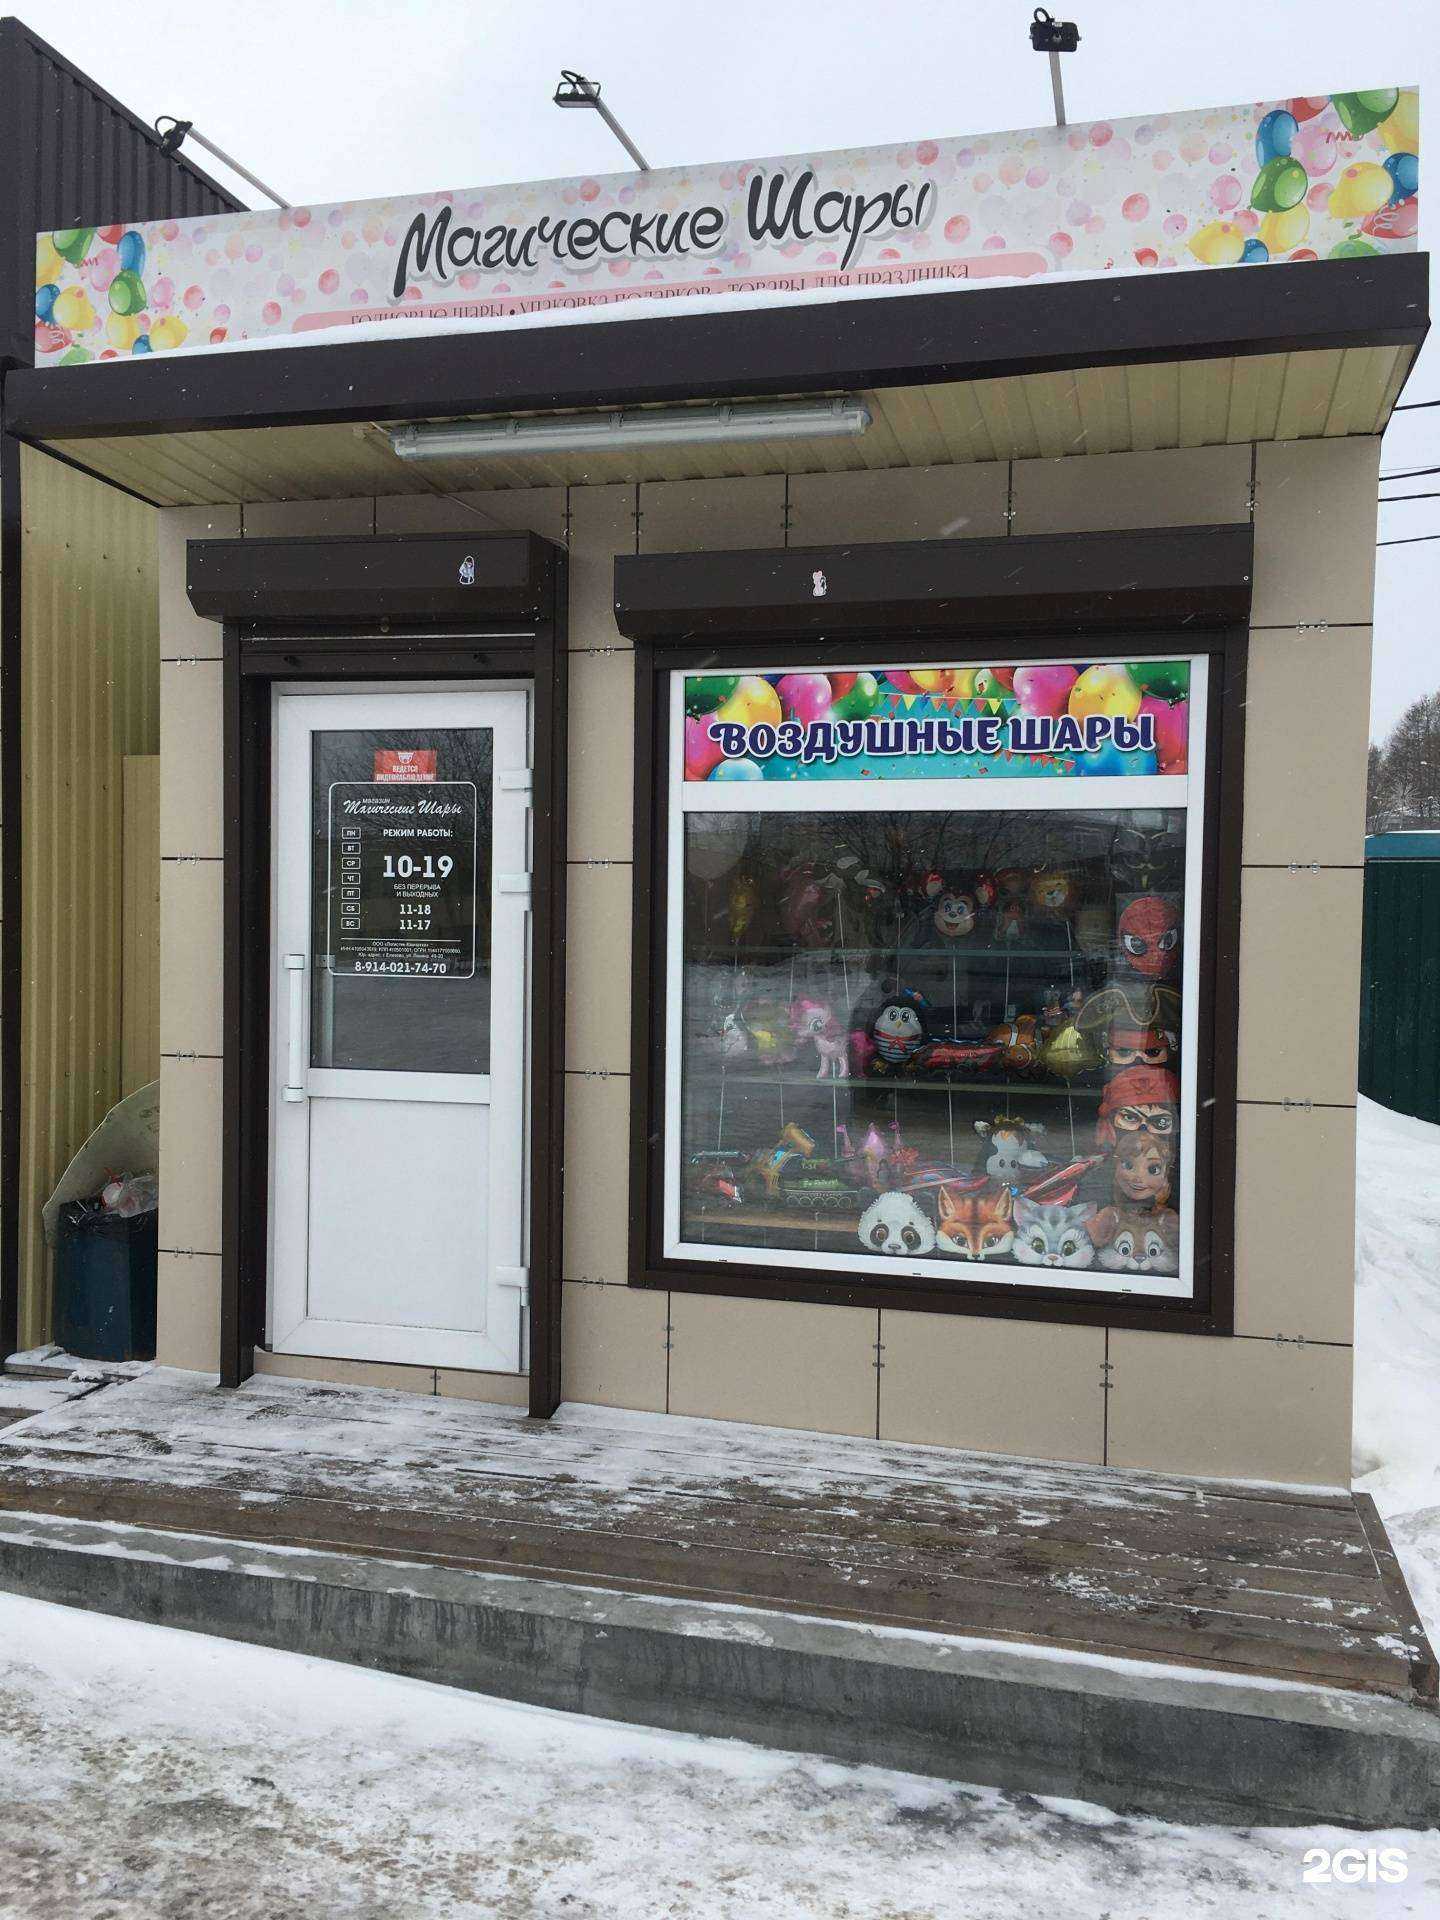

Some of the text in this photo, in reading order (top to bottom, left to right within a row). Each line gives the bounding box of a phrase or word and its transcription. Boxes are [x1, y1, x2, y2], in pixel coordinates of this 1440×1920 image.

[393, 171, 931, 298] Магические Шары
[708, 714, 1157, 763] ВОЗДУШНЫЕ ШАРЫ
[417, 800, 463, 818] Шары
[383, 829, 454, 838] РЕЖИМ РАБОТЫ:
[383, 855, 454, 878] 10-19
[400, 904, 432, 915] 11-18
[400, 919, 432, 930] 11-17
[354, 961, 447, 974] 8-914-021-74-70
